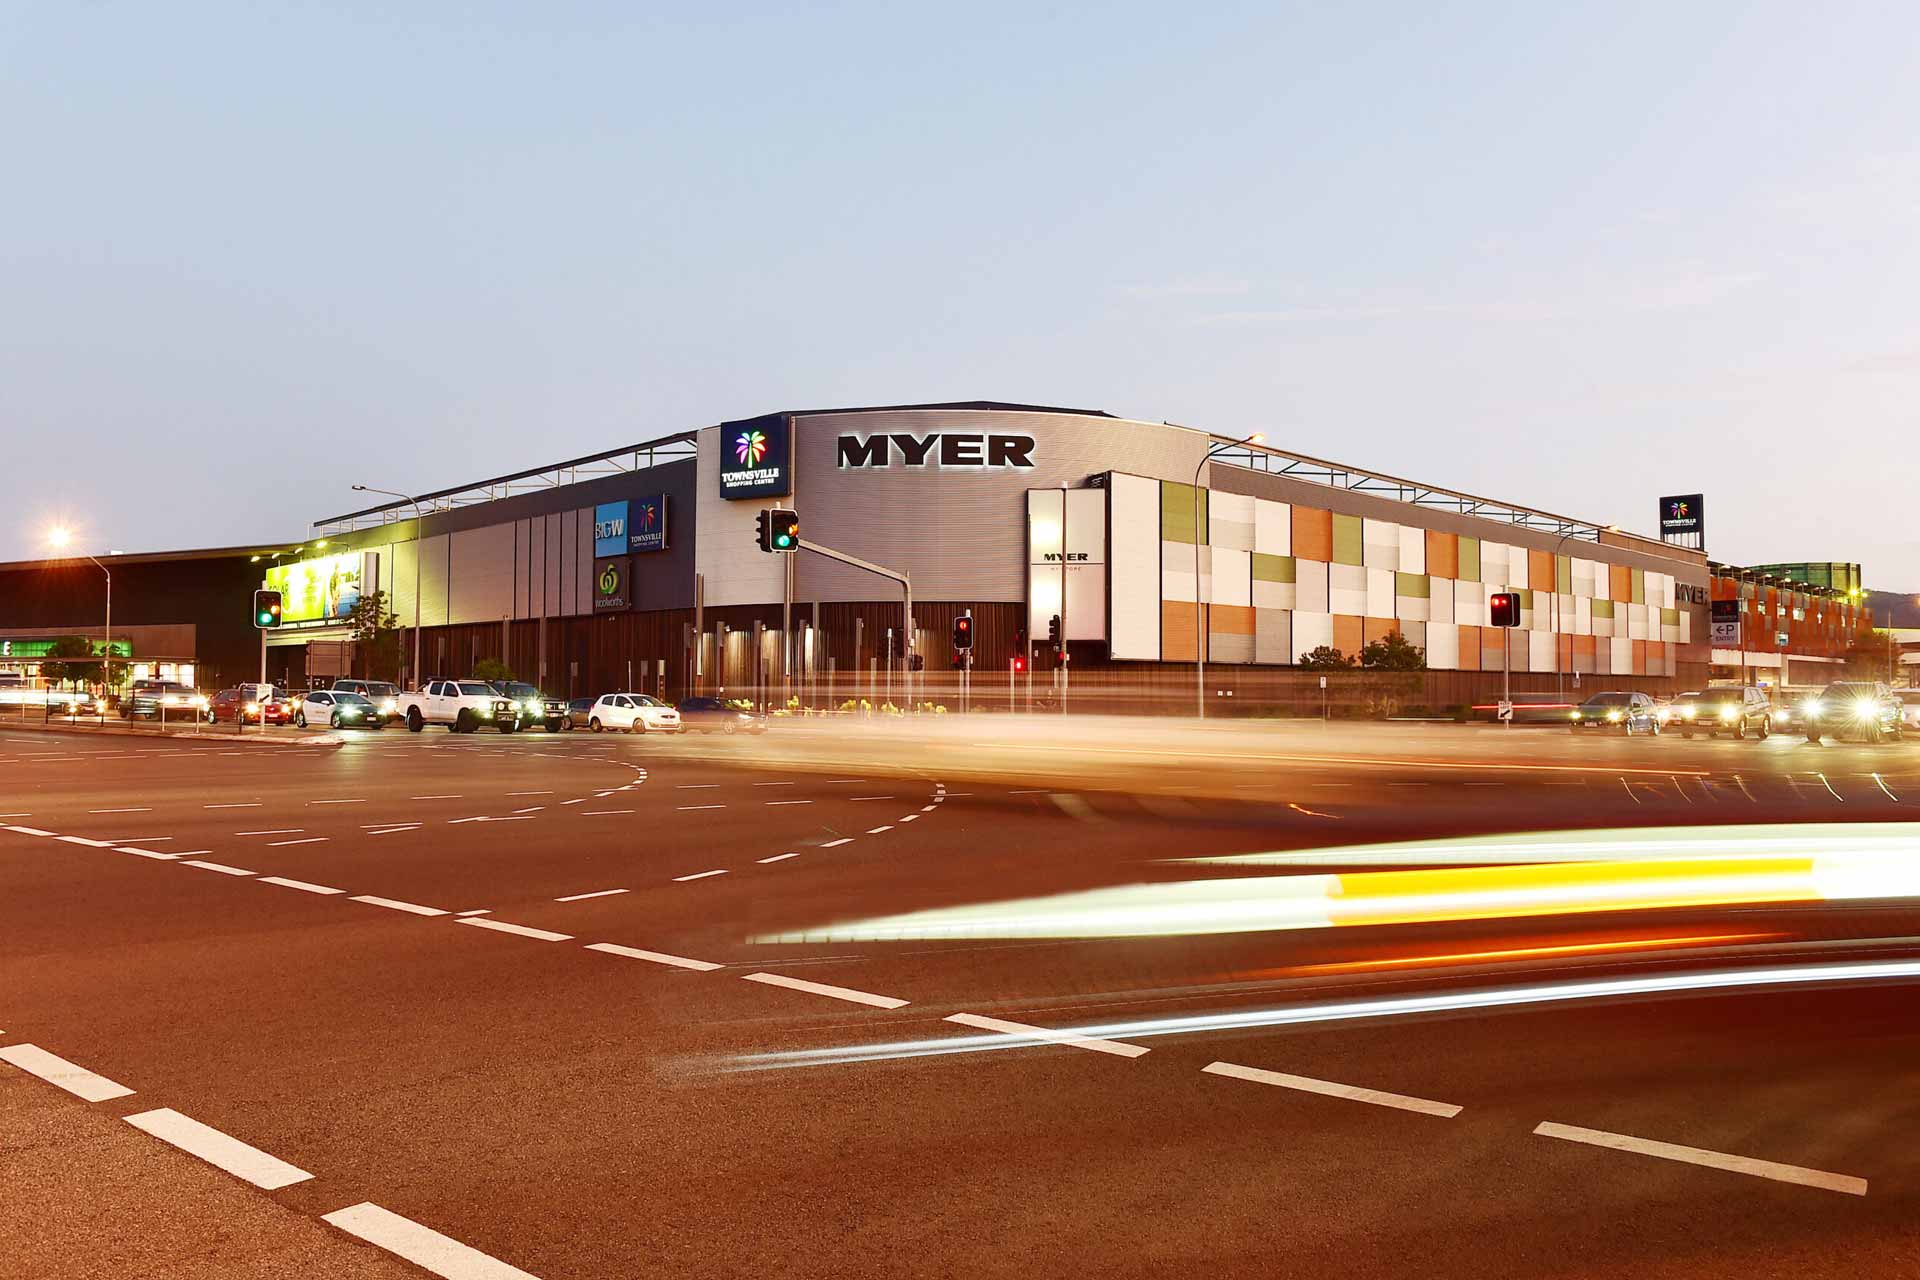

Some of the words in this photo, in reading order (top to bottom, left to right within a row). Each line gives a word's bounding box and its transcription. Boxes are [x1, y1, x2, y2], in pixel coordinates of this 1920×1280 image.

[837, 433, 1035, 468] MYER
[721, 467, 780, 483] TOWNSVILLE
[726, 480, 753, 488] SHOPPING
[753, 477, 775, 486] CENTRE
[631, 532, 662, 543] TOWNSVILLE
[1043, 553, 1089, 561] MYER
[1726, 624, 1735, 635] P
